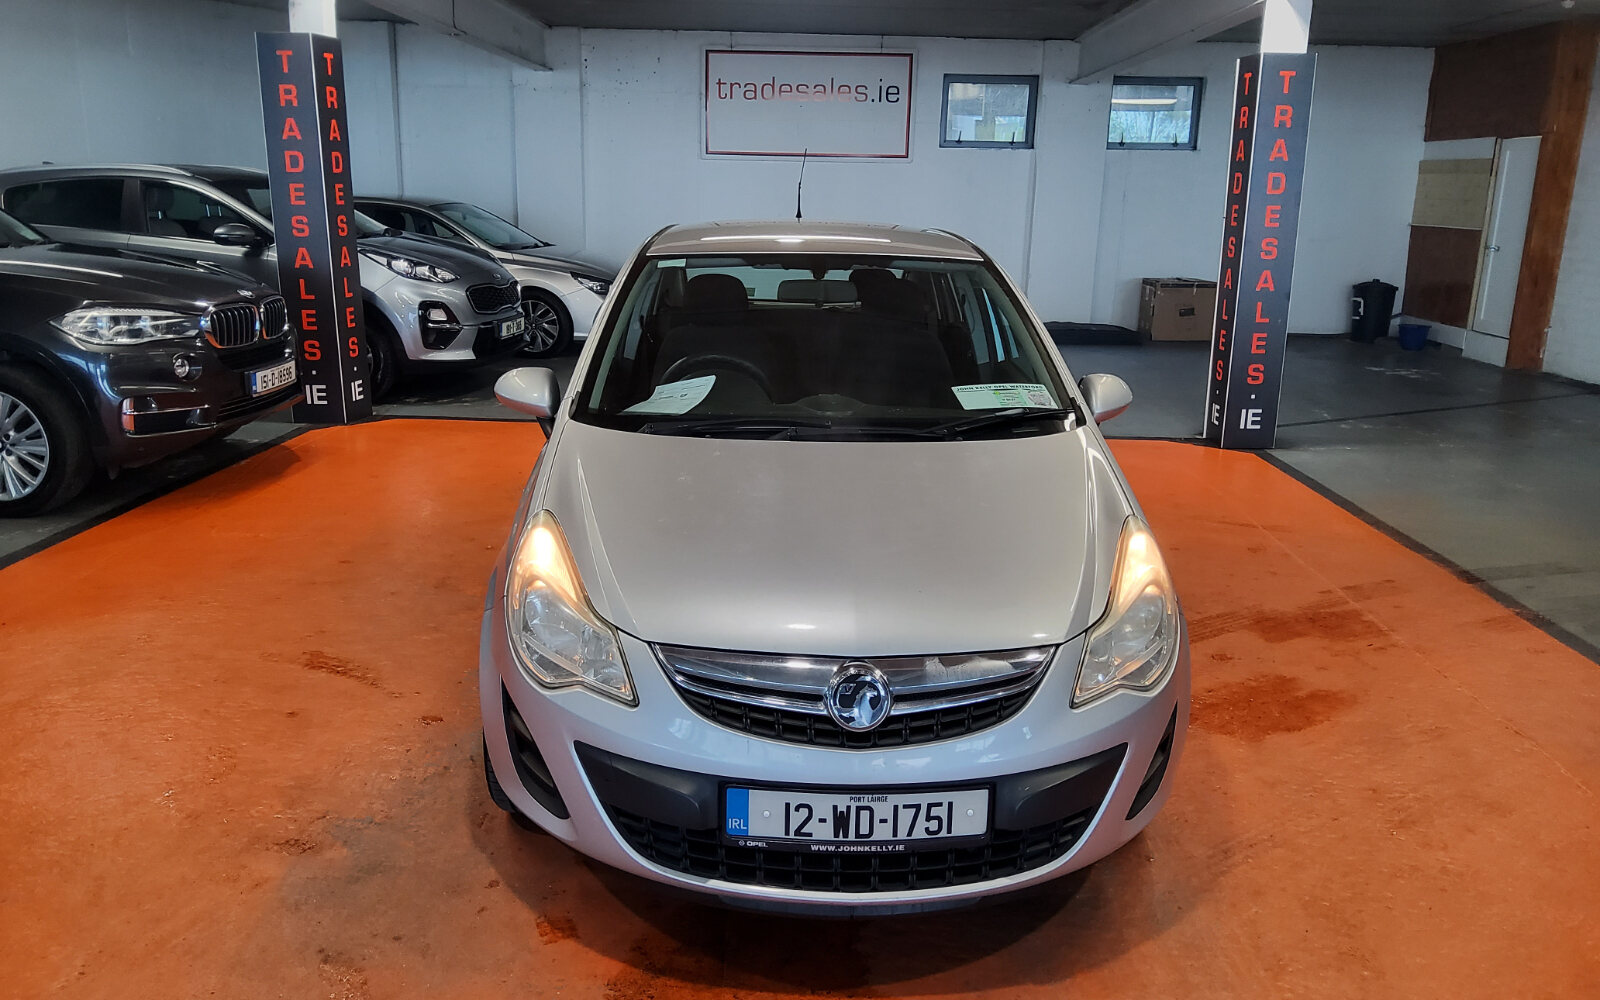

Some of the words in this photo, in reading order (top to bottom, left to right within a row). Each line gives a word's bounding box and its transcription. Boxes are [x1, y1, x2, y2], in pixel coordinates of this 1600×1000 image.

[716, 76, 900, 103] tradesales.ie
[260, 366, 293, 390] 151-D-18596
[849, 795, 866, 803] PORT
[867, 794, 888, 803] LÁIRGE
[728, 818, 747, 830] IRL
[784, 801, 953, 839] 12-WD-1751
[746, 840, 769, 848] OPEL
[810, 844, 906, 852] WWW.JOHNKELLY.IE
